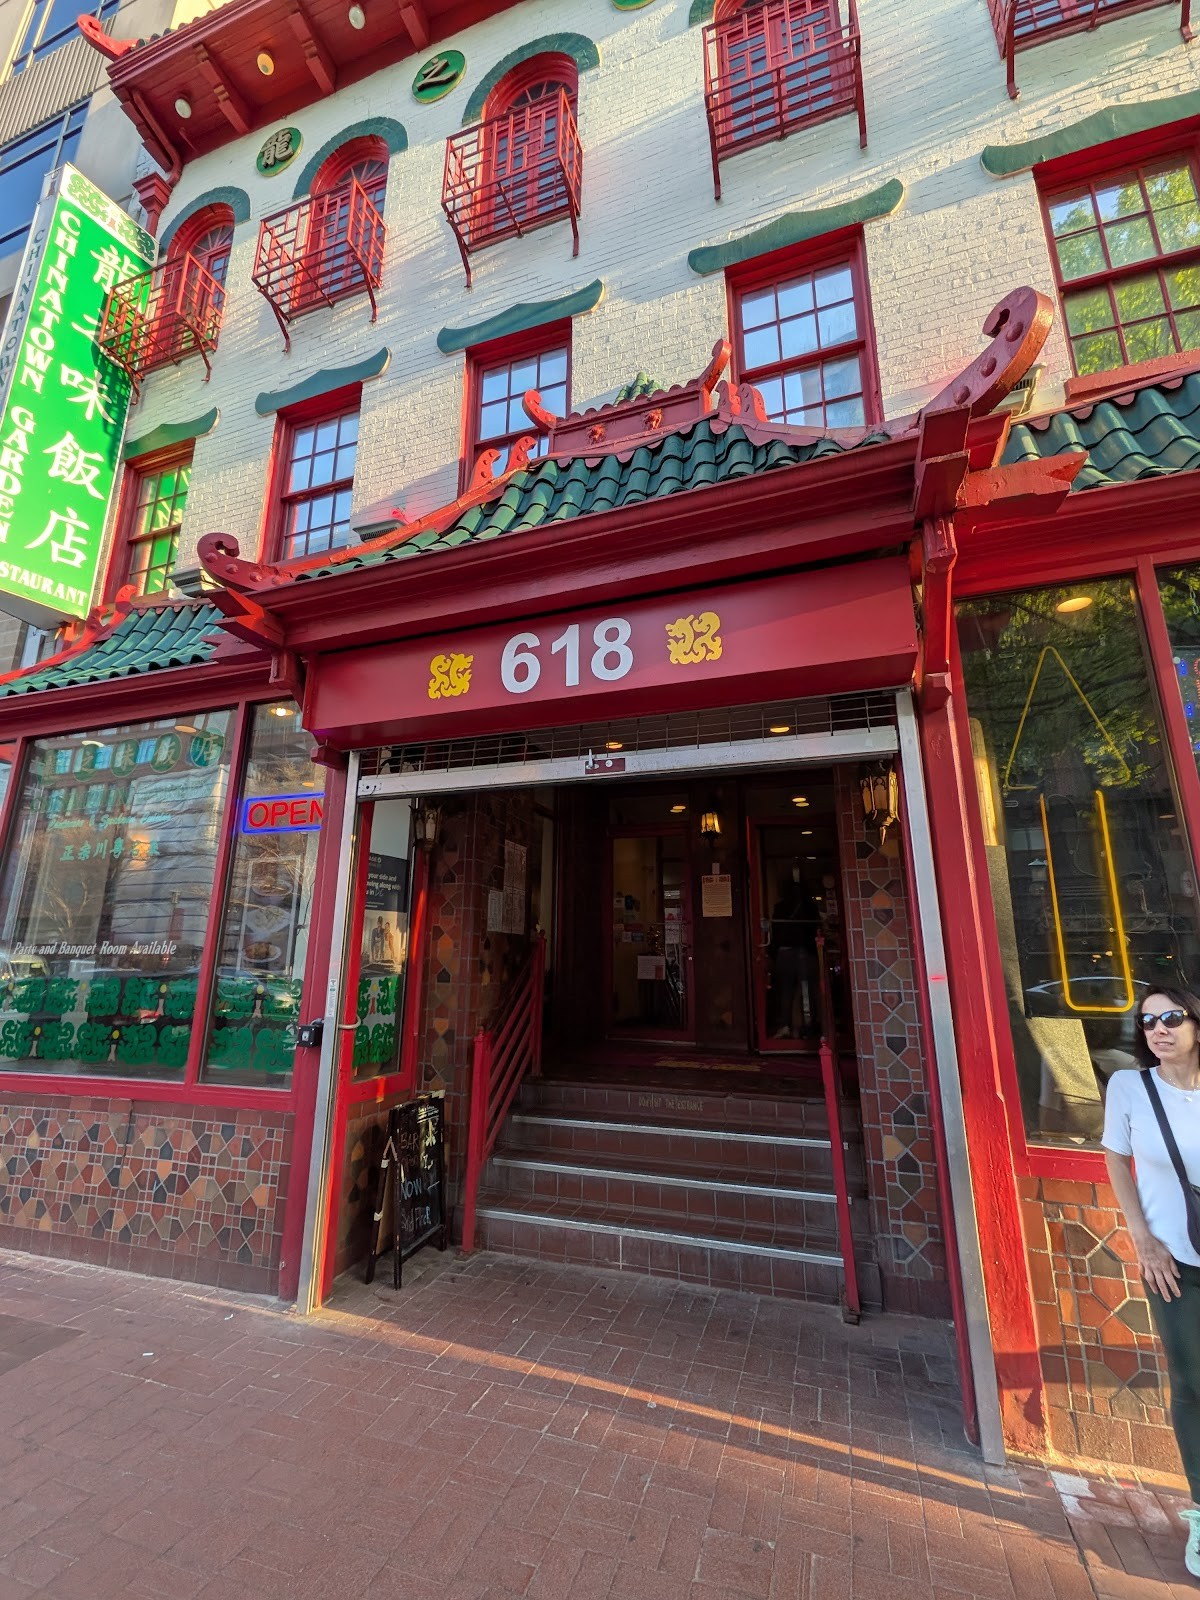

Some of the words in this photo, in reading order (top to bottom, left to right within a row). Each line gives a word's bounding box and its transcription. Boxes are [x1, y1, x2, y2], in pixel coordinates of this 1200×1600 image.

[261, 130, 294, 169] 龍
[416, 58, 459, 91] 之
[20, 210, 82, 394] CHINATOWN
[501, 617, 634, 694] 618
[248, 800, 324, 828] OPEN
[39, 941, 57, 954] and
[58, 942, 97, 957] Banquet
[100, 941, 127, 954] Room
[130, 940, 177, 954] Available
